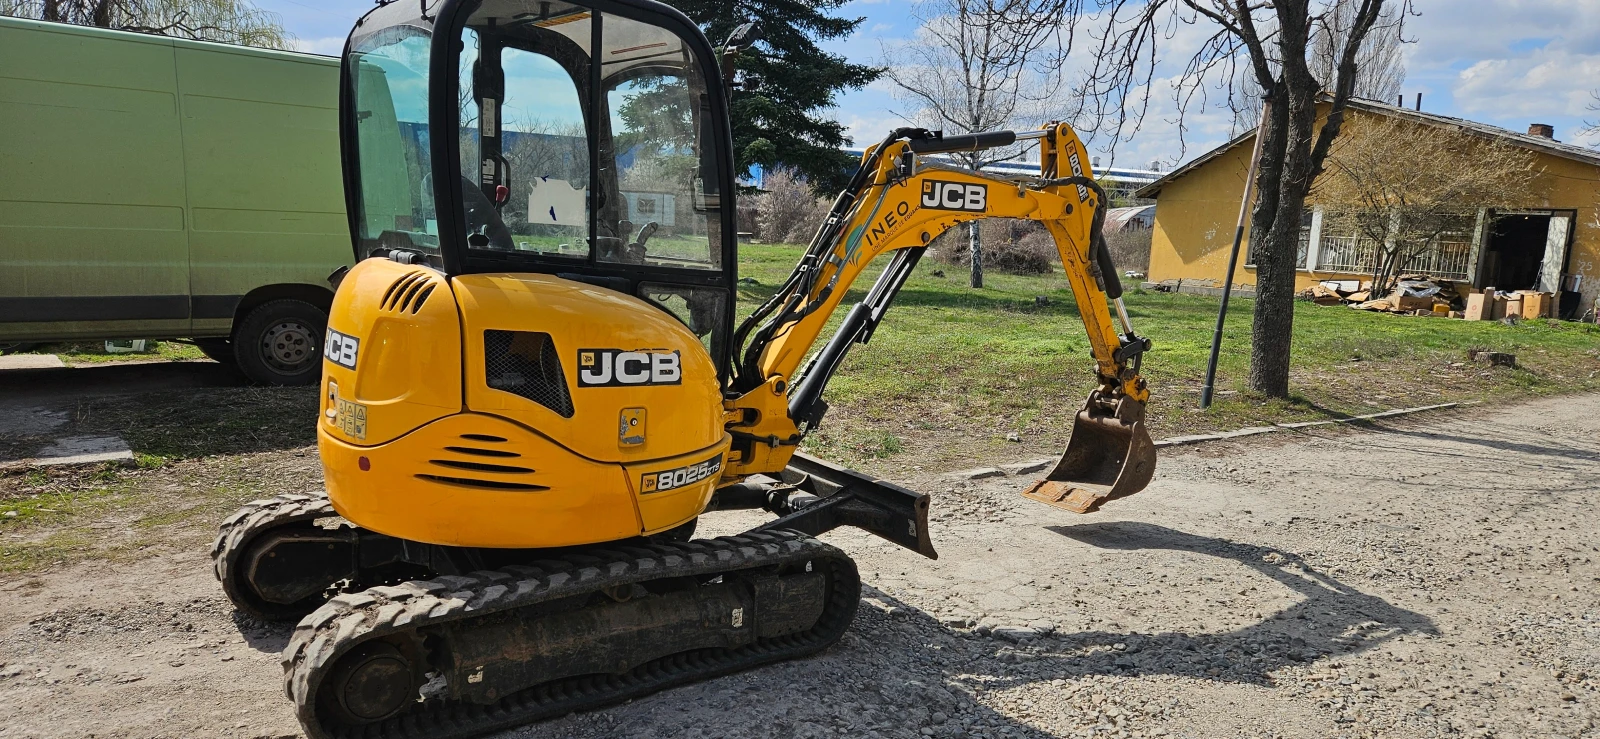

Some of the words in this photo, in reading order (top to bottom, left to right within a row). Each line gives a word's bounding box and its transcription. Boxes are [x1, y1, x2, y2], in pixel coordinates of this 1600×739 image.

[922, 182, 986, 210] JCB
[865, 201, 909, 246] INEO
[580, 352, 681, 384] JCB
